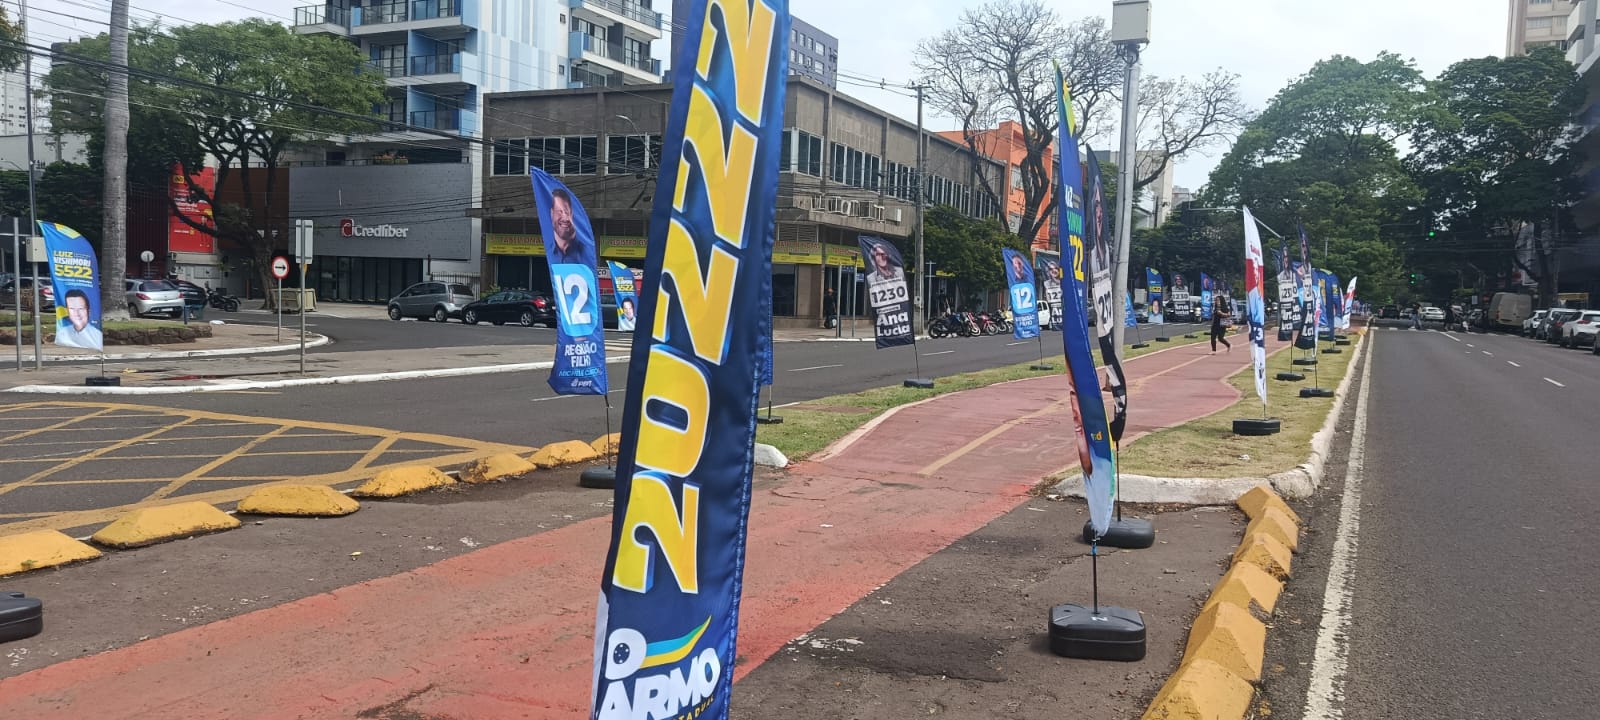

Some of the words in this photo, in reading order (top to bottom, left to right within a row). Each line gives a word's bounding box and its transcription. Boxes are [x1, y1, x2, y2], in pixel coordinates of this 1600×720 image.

[55, 263, 93, 279] 5522
[554, 274, 591, 325] 12
[871, 286, 906, 304] 1230
[1013, 287, 1033, 310] 12
[877, 312, 908, 326] Ana
